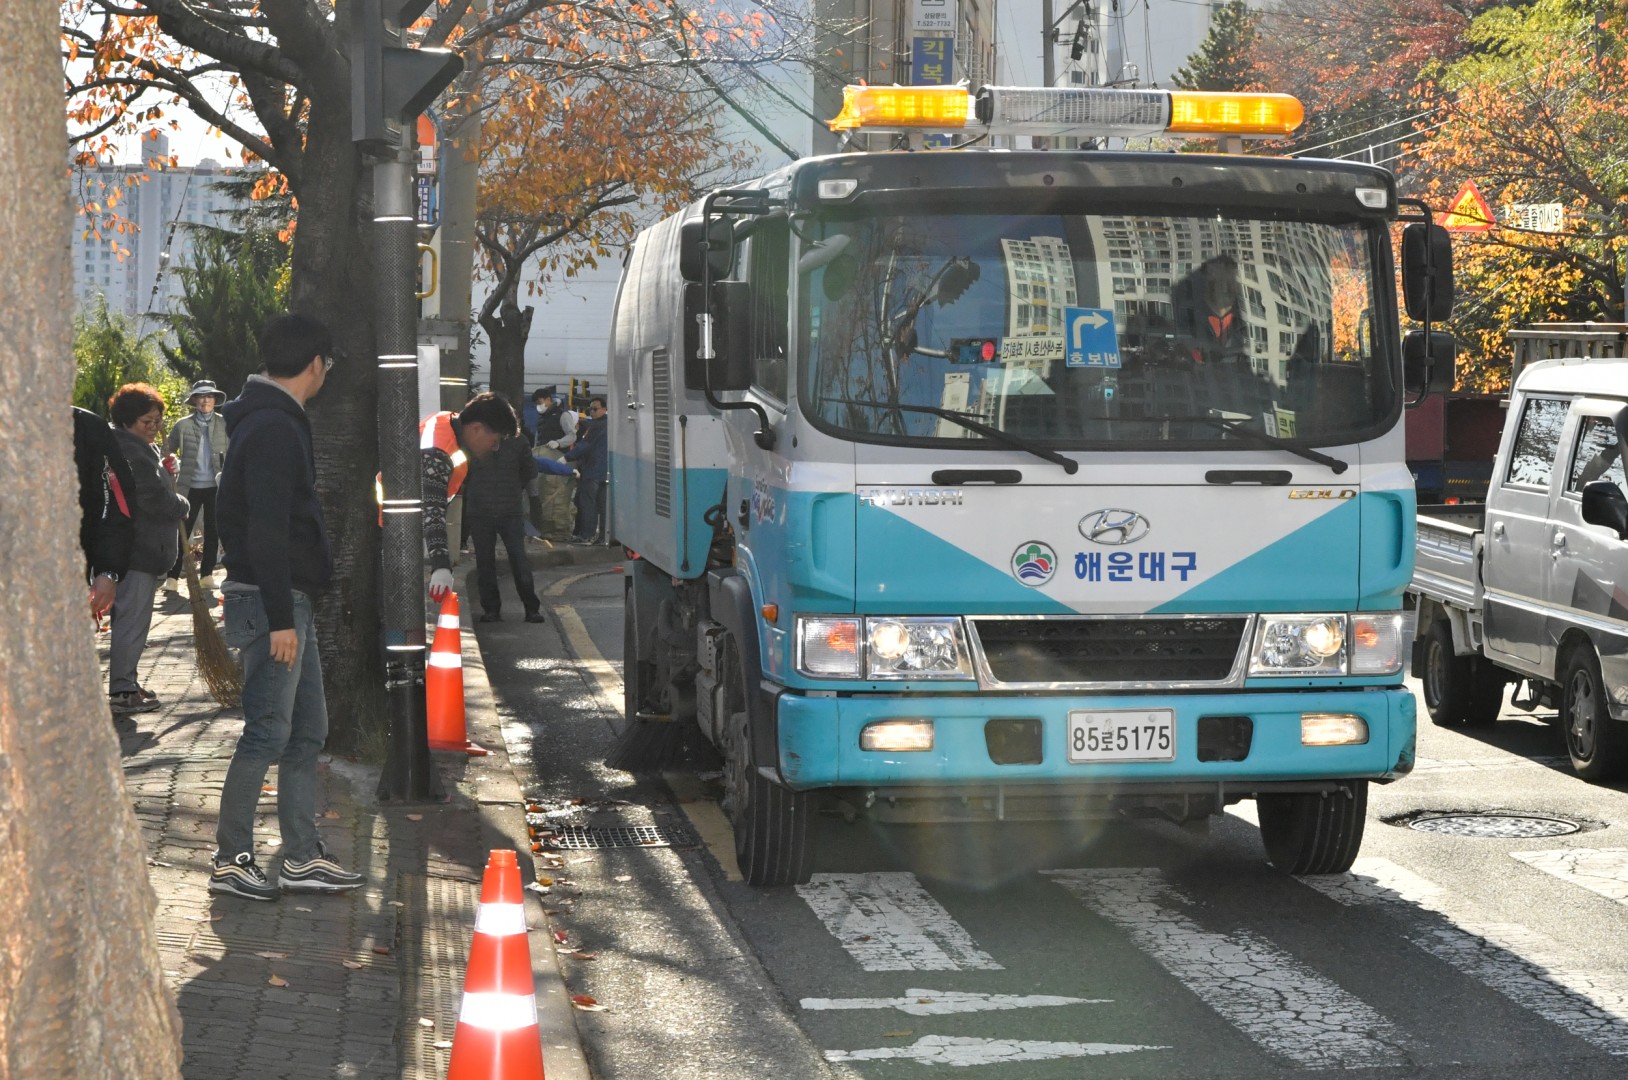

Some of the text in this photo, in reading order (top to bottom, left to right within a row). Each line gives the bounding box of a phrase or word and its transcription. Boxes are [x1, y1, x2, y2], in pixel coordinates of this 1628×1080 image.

[860, 488, 963, 506] HYUNDAI
[1288, 489, 1357, 500] GOLD
[1074, 551, 1198, 582] 해운대구
[1073, 725, 1170, 752] 85로5175
